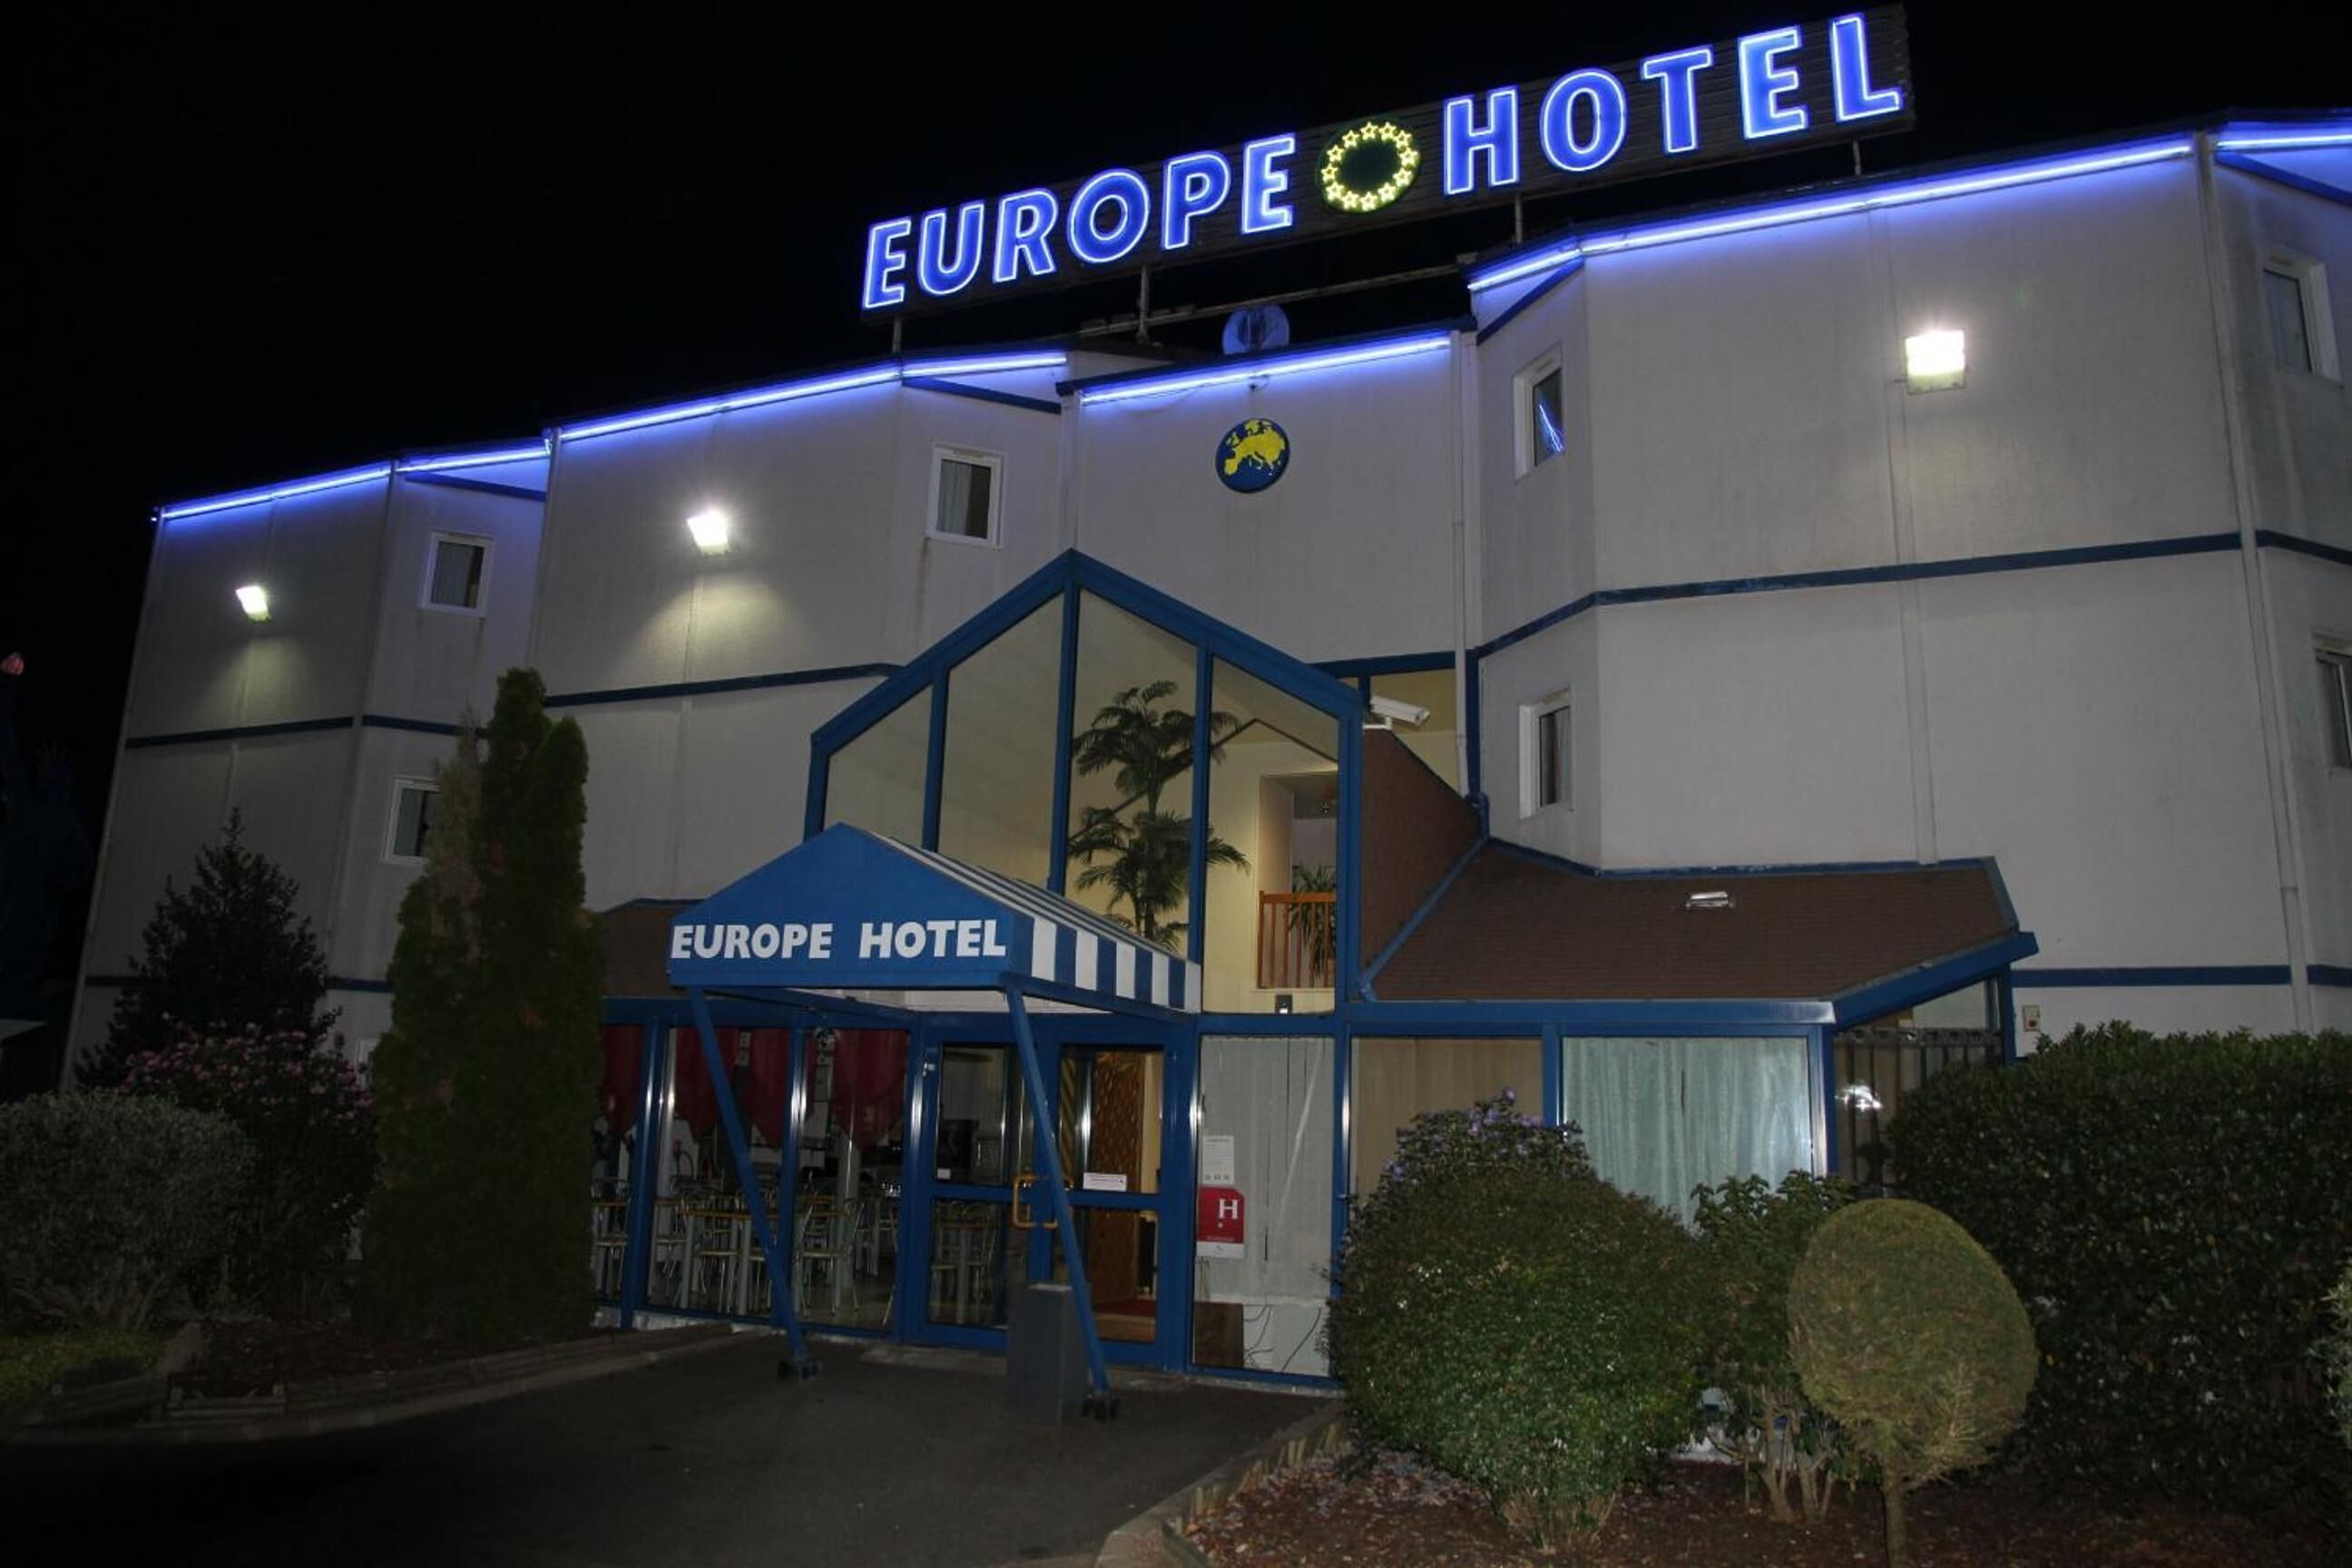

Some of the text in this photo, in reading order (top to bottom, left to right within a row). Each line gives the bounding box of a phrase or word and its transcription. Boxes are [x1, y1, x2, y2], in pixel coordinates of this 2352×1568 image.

[861, 12, 1903, 311] EUROPE HOTEL
[670, 919, 1006, 959] EUROPE HOTEL
[1219, 1199, 1239, 1220] H
